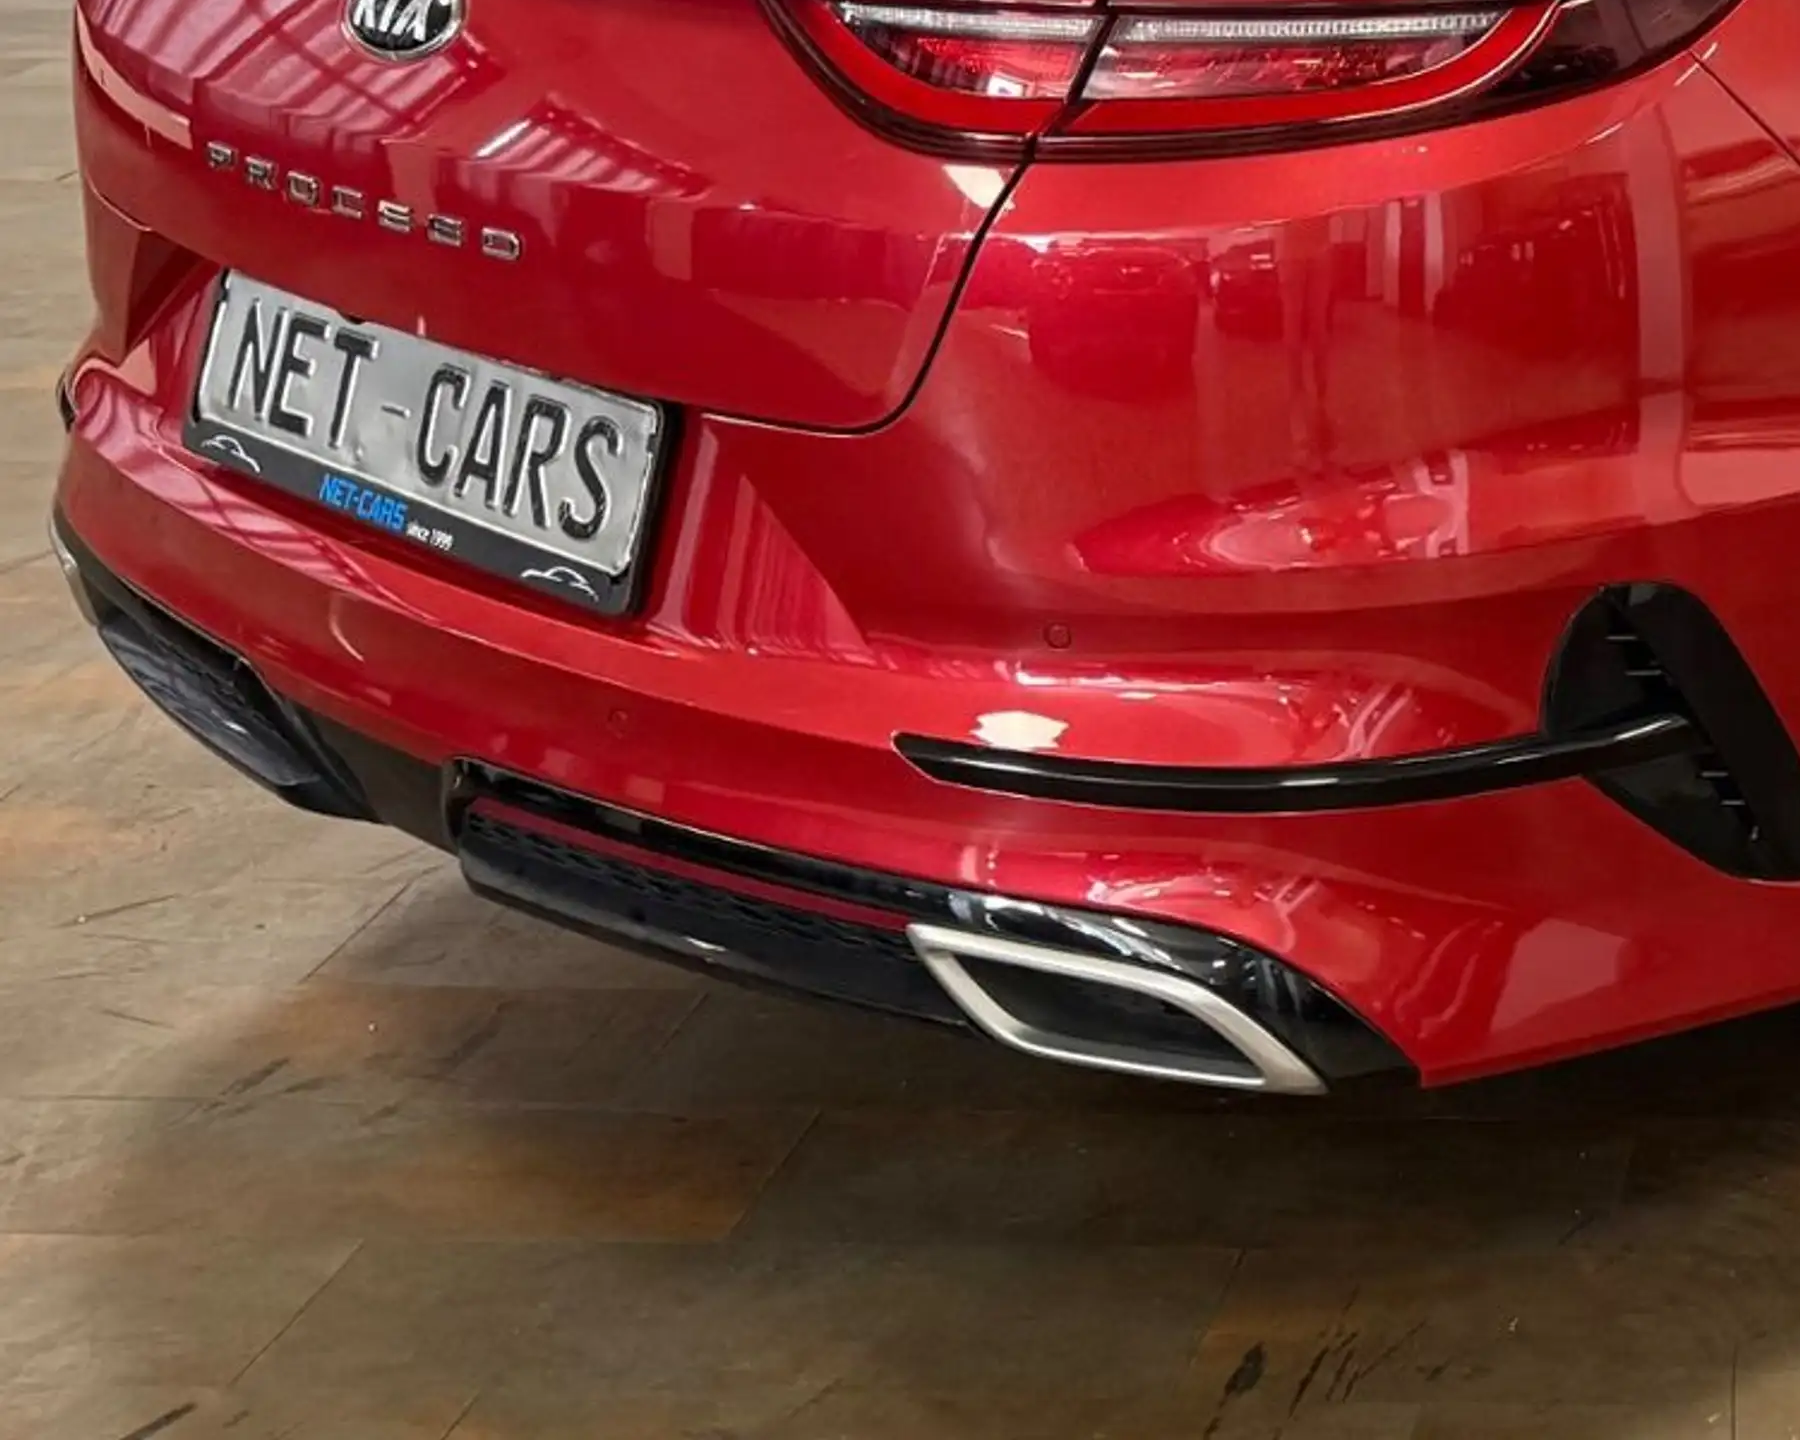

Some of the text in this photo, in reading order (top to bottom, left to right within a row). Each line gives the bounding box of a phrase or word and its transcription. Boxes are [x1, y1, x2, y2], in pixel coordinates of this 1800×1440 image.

[206, 141, 521, 260] PROCEED
[228, 298, 379, 450] NET
[415, 363, 624, 540] CARS
[318, 473, 408, 532] NET-CARS
